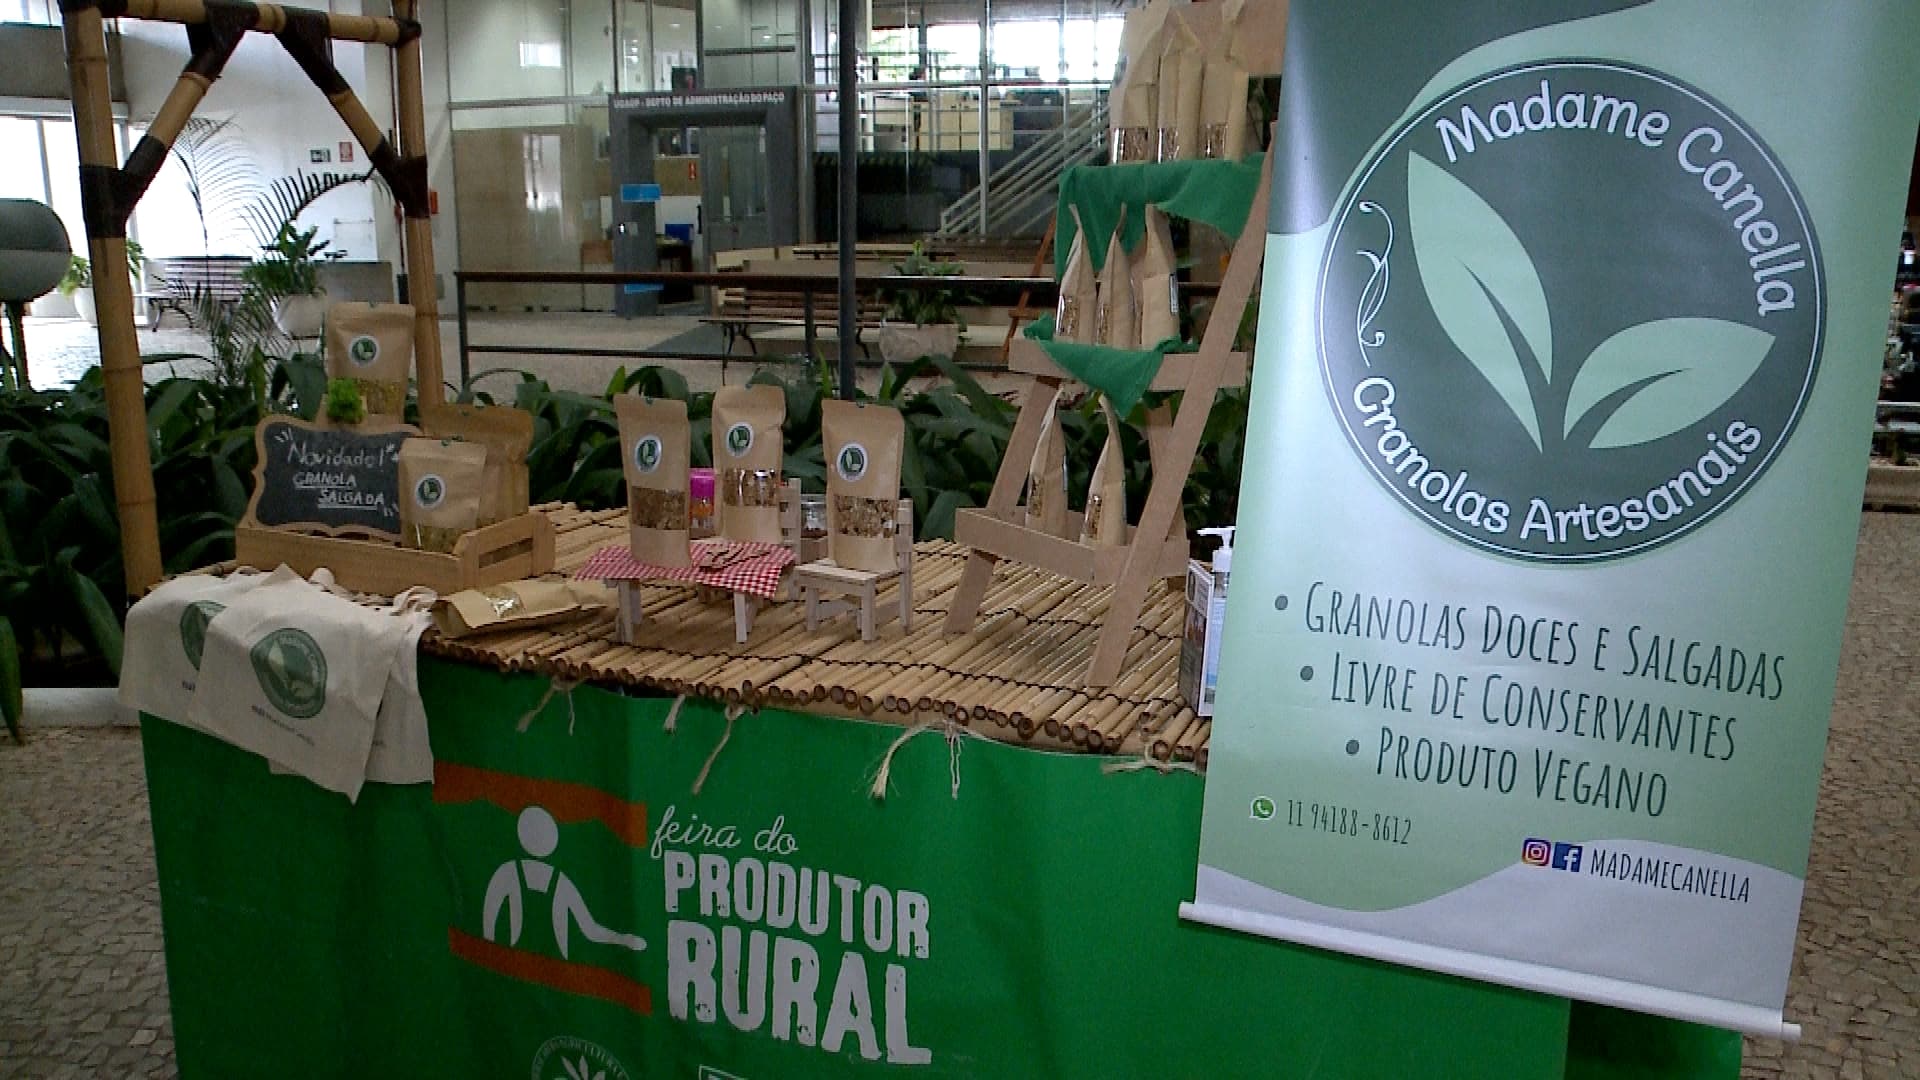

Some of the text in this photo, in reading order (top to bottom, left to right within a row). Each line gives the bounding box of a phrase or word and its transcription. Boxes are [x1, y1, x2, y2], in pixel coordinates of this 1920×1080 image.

[1436, 79, 1806, 317] Madame Canella
[292, 471, 357, 488] GRANOLA
[318, 489, 385, 506] SALGADA
[1352, 376, 1762, 543] Granolas Artesanais
[1305, 581, 1785, 700] GRANOLAS DOCES E SALGADAS
[1331, 652, 1737, 760] LIVRE DE CONSERVANTES
[1377, 726, 1667, 817] PRODUTO VEGANO
[651, 805, 799, 859] feira do
[1288, 800, 1412, 844] 11 94188-8612
[664, 850, 930, 959] PRODUTOR
[1590, 848, 1750, 903] MADAMECANELLA
[667, 919, 932, 1065] RURAL
